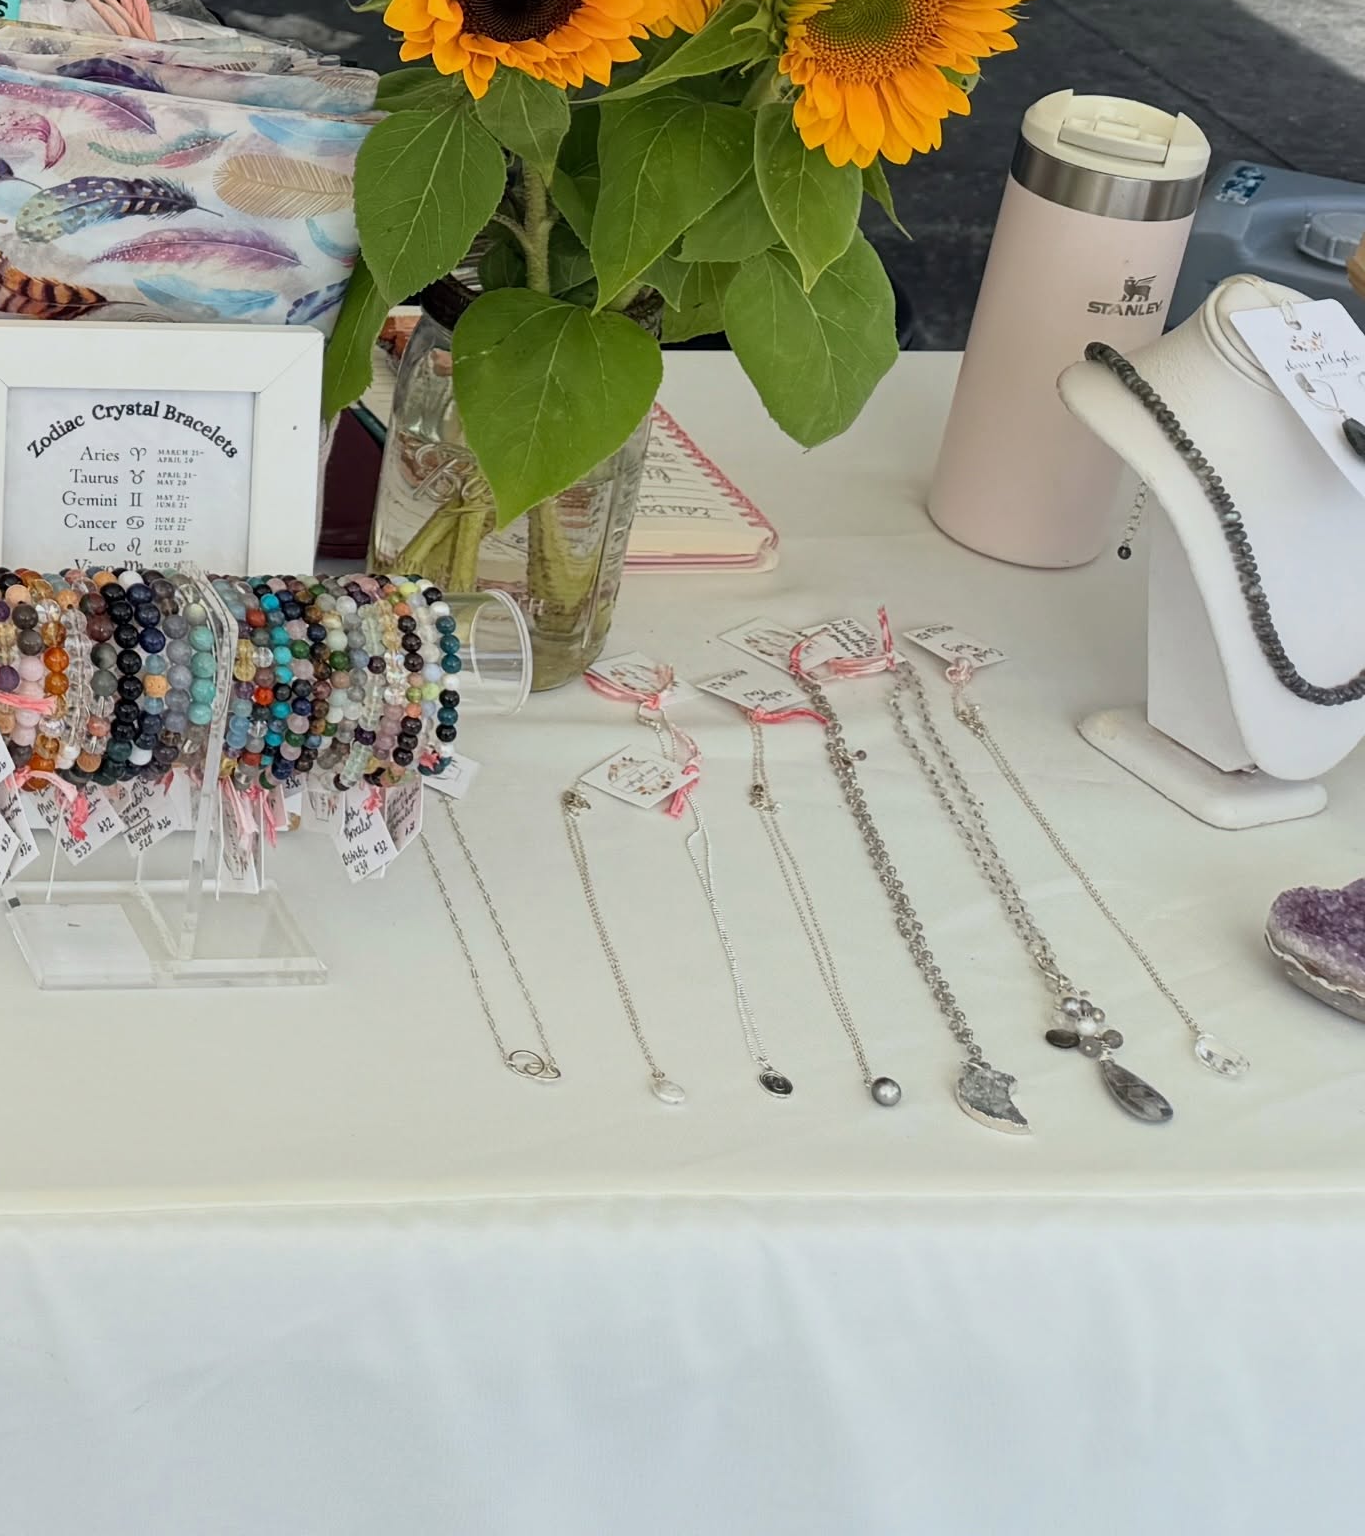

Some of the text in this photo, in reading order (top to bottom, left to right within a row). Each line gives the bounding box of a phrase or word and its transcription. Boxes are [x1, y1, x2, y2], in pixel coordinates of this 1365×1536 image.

[1087, 299, 1163, 317] STANLEY
[26, 400, 238, 459] Zodiac Crystal Bracelets
[80, 446, 120, 462] Aries
[157, 448, 188, 456] MARCH
[157, 456, 182, 464] APRIL
[70, 468, 119, 484] Taurus
[156, 471, 180, 479] APRIL
[62, 490, 117, 507] Gemini
[156, 494, 173, 502] MAY
[64, 513, 117, 529] Cancer
[155, 524, 174, 532] JULY
[88, 537, 116, 552] Leo
[153, 539, 174, 547] JULY
[153, 546, 170, 554] AUG
